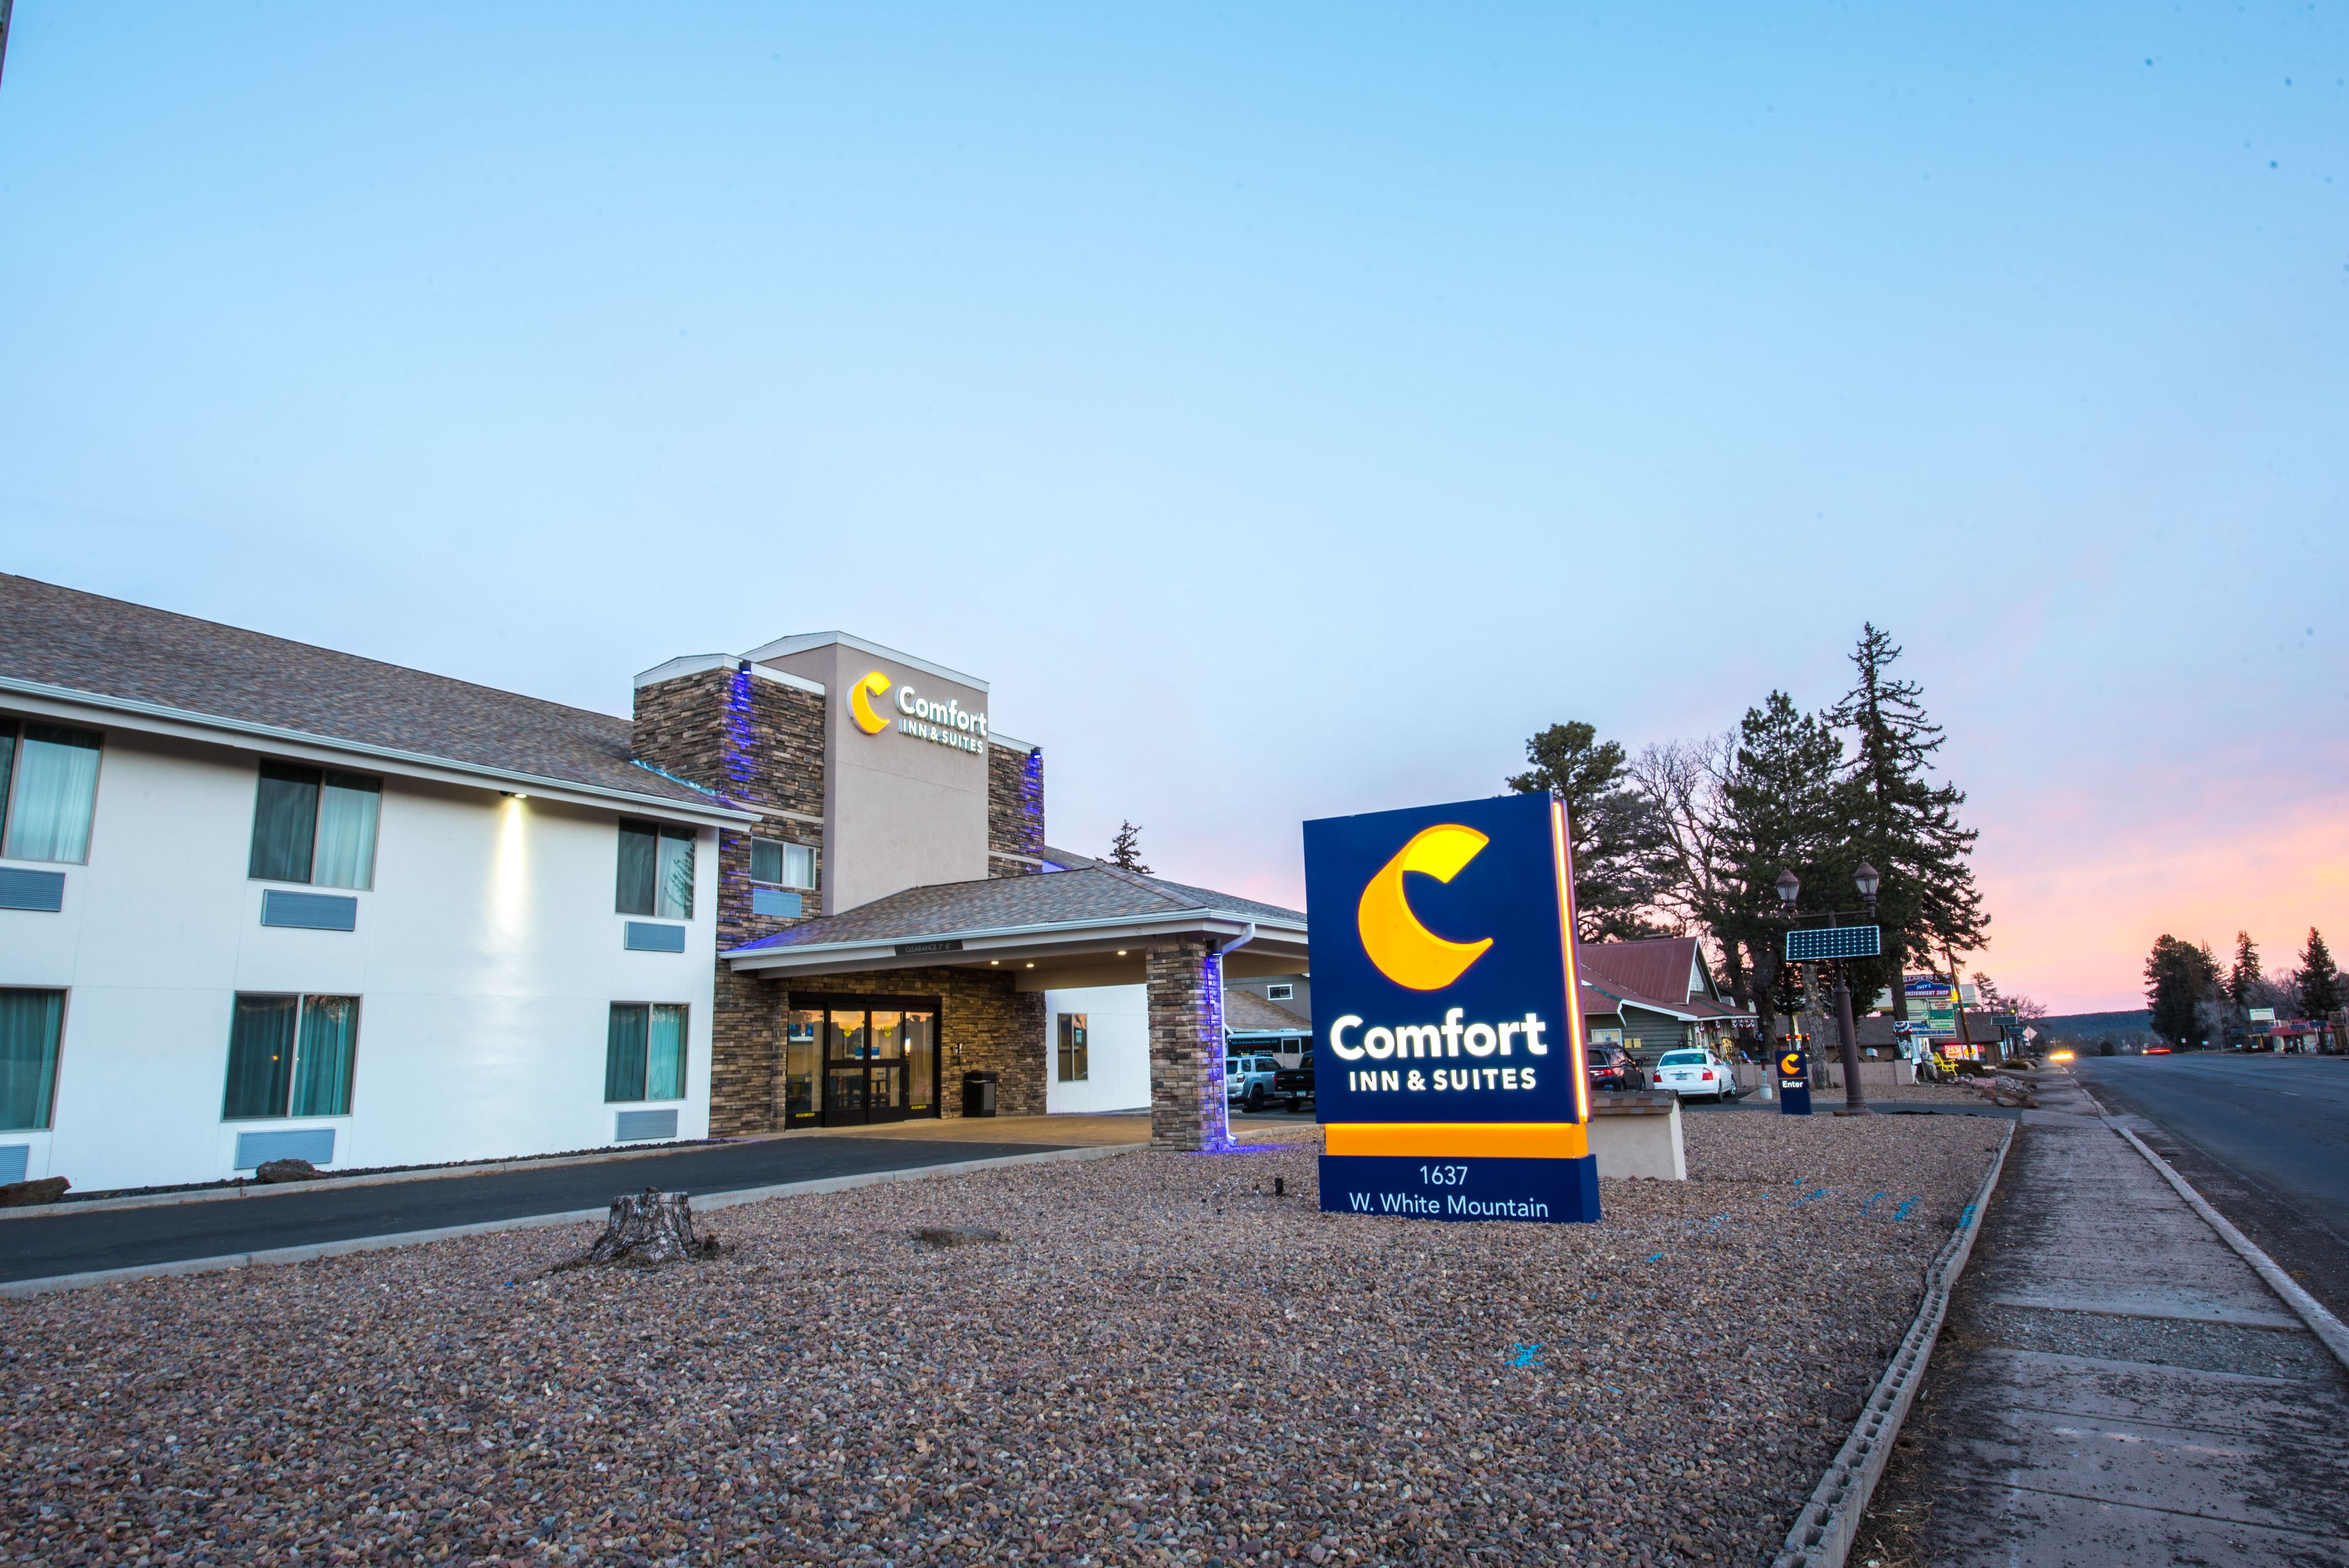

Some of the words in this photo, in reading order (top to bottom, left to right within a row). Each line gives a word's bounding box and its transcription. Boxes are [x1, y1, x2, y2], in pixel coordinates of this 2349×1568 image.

[897, 685, 987, 737] Comfort
[901, 719, 927, 738] INN
[930, 728, 939, 741] &
[941, 730, 984, 754] SUITES
[905, 944, 937, 953] CLEARANCE
[1330, 1007, 1548, 1060] Comfort
[1349, 1071, 1399, 1091] INN
[1407, 1069, 1427, 1091] &
[1433, 1068, 1537, 1091] SUITES
[1419, 1165, 1468, 1186] 1637
[1349, 1192, 1374, 1211] W.
[1380, 1193, 1441, 1214] White
[1447, 1195, 1548, 1217] Mountain
